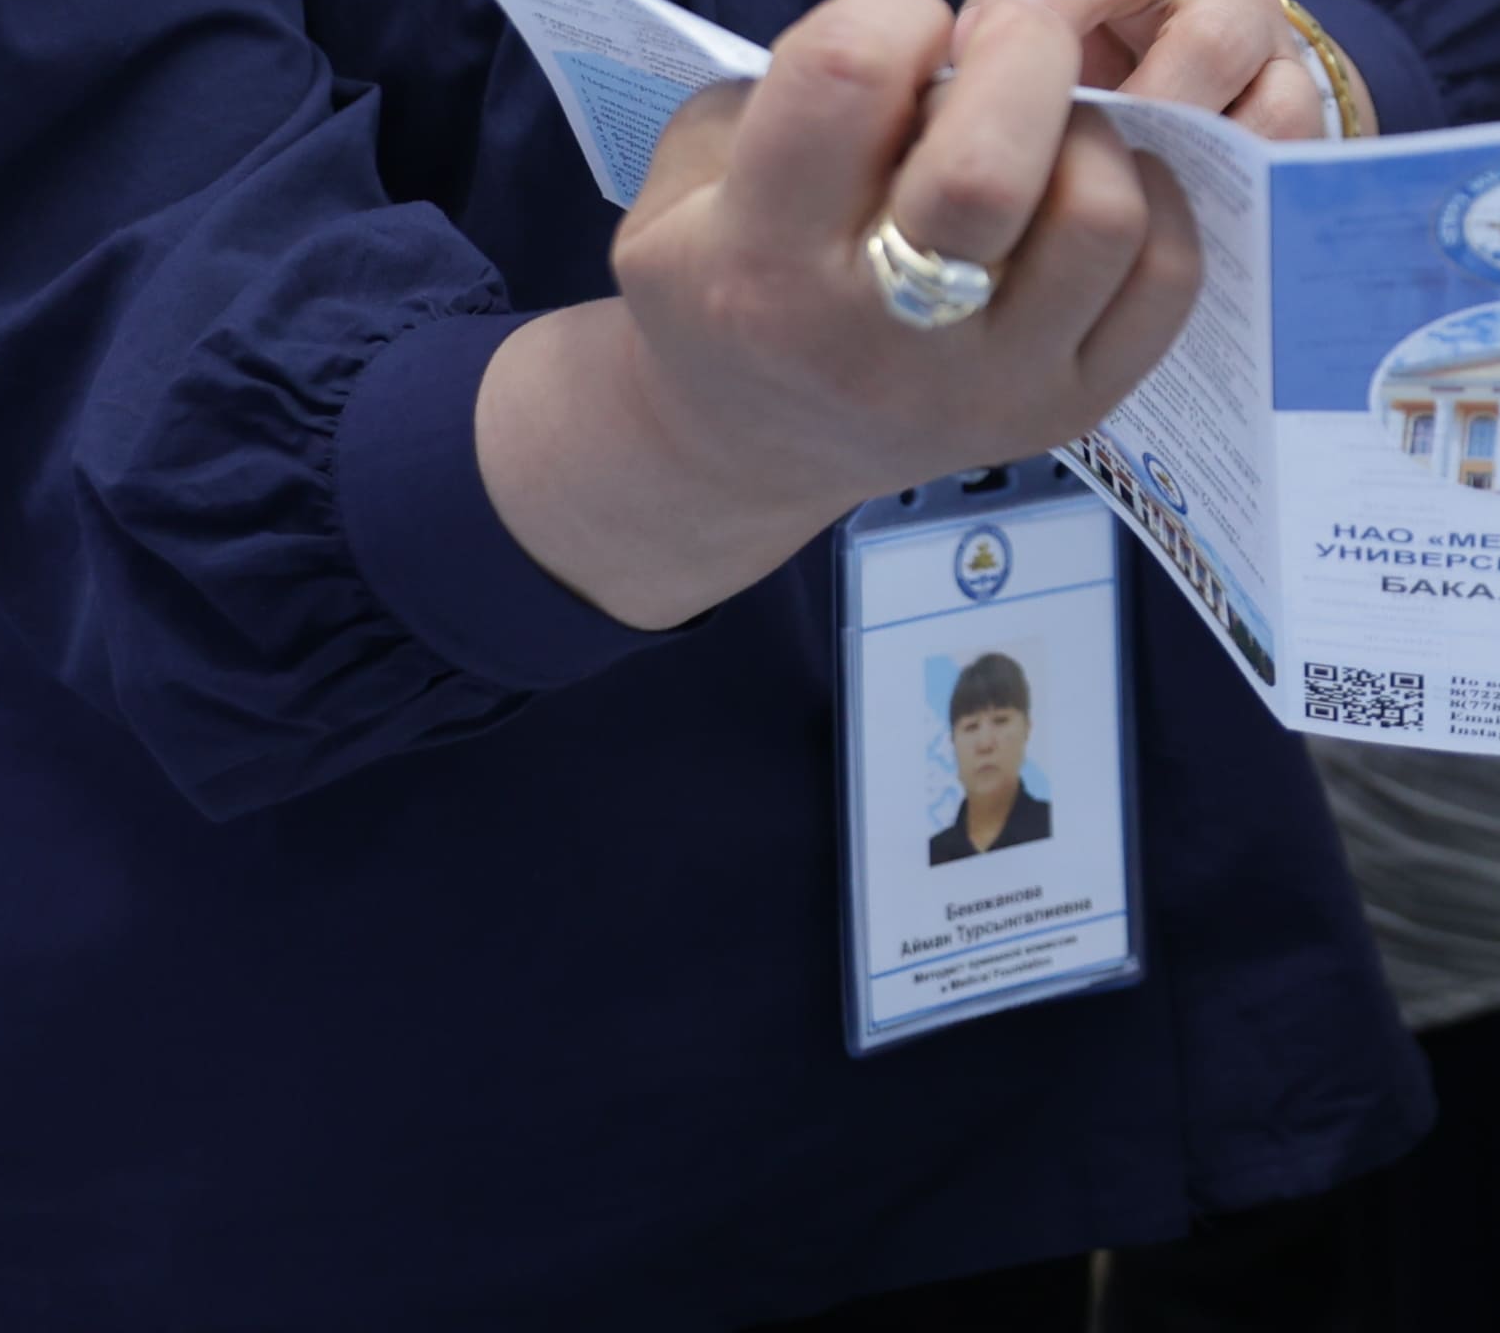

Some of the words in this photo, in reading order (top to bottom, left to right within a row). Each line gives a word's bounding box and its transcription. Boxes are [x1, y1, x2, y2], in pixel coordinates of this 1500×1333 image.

[1333, 523, 1414, 544] НАО
[1449, 676, 1479, 687] По
[901, 933, 952, 958] Айман
